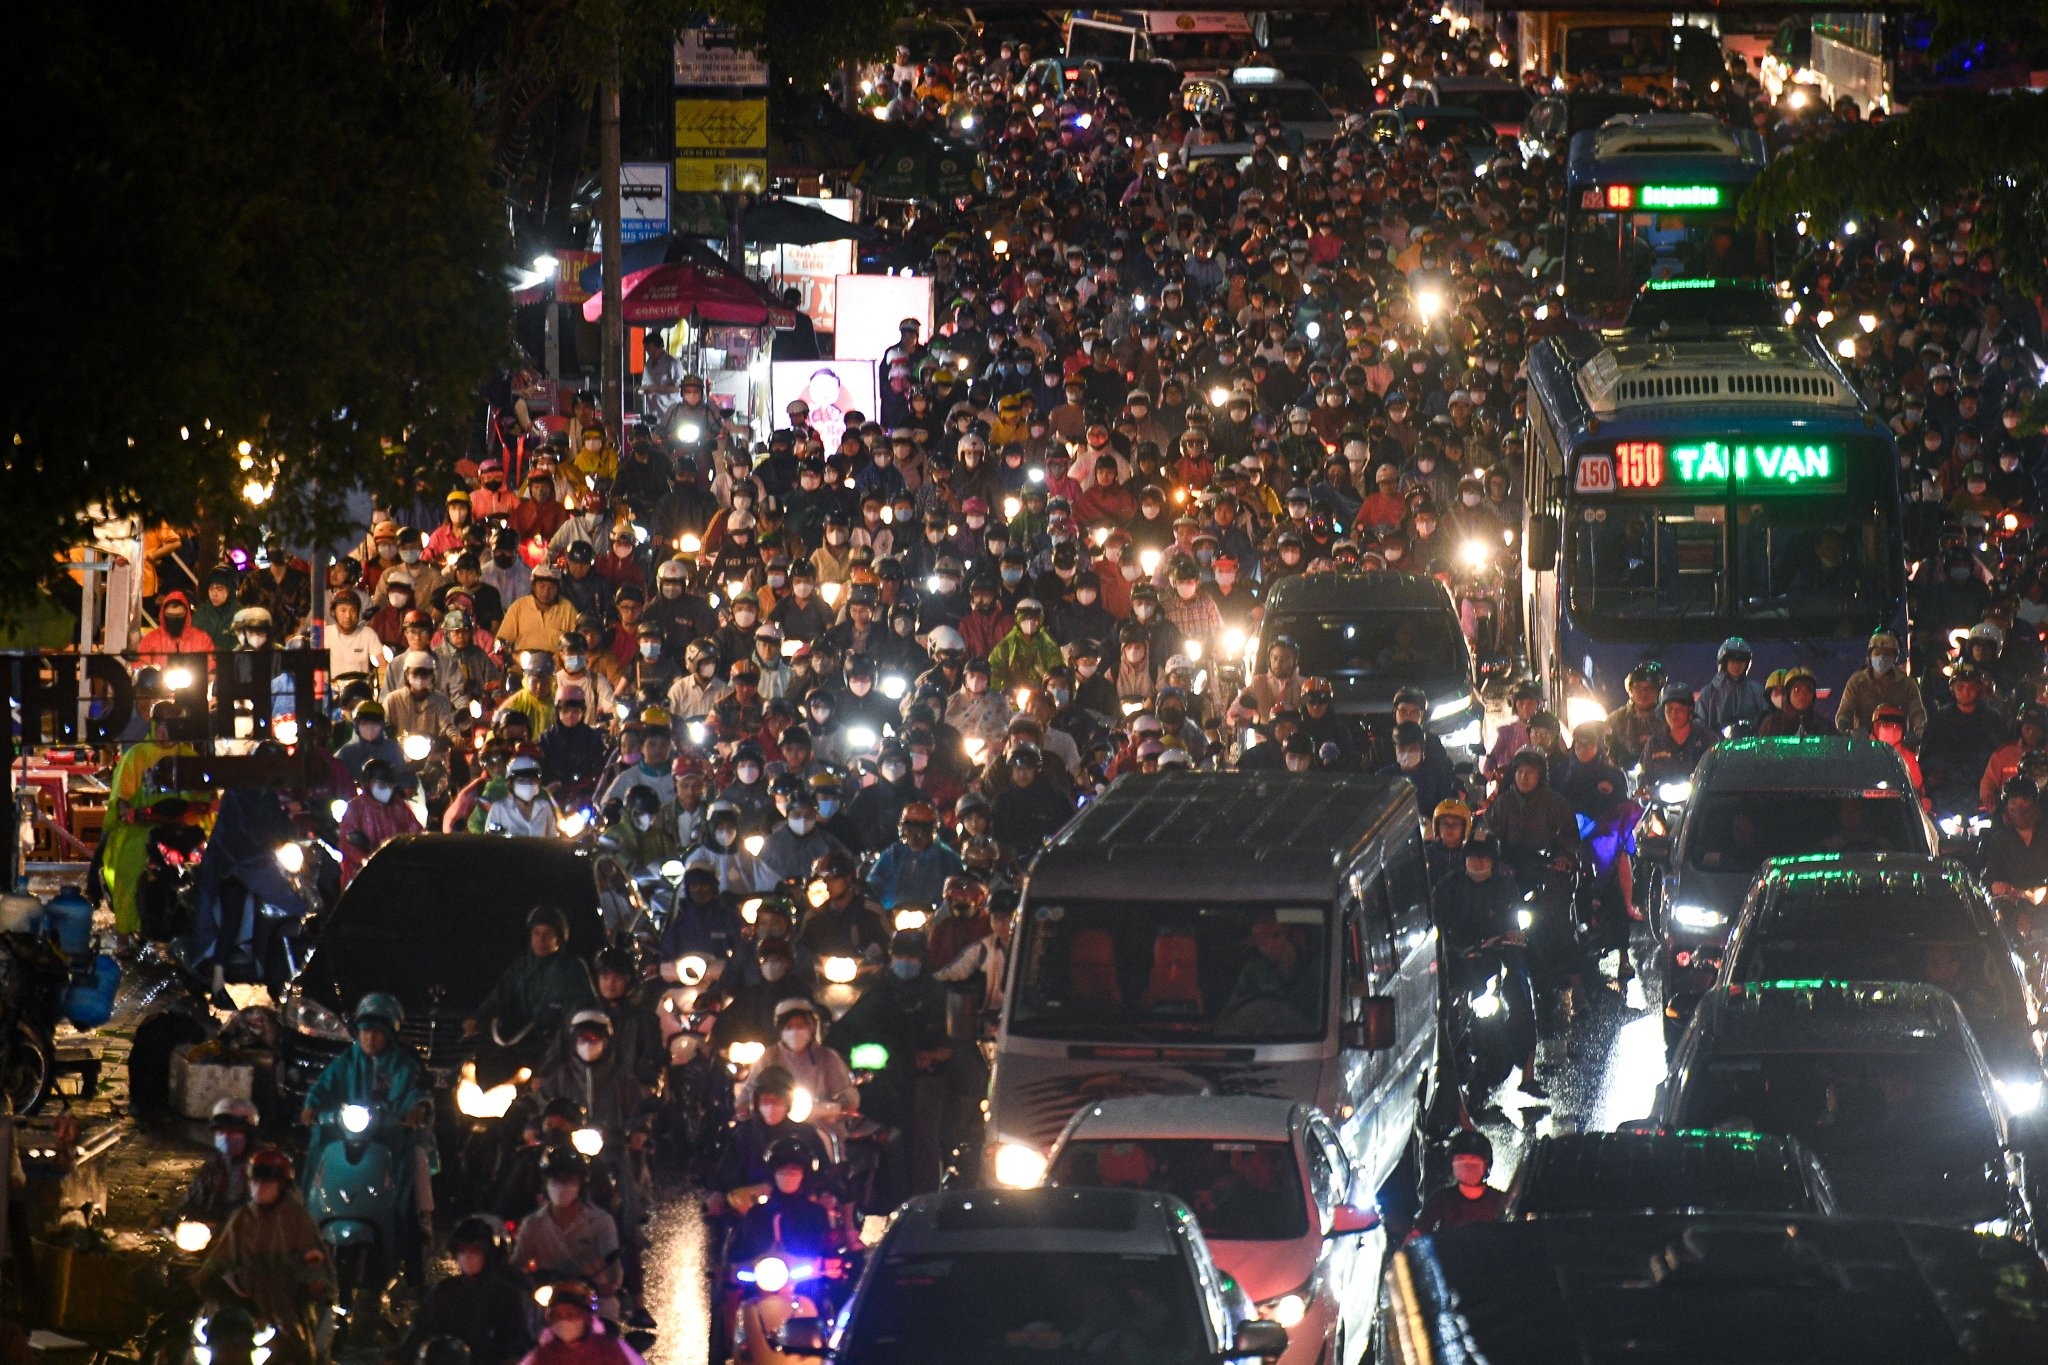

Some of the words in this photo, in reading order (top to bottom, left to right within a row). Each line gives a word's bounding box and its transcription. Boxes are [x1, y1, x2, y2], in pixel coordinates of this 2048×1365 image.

[1608, 185, 1631, 208] 52
[1580, 461, 1610, 488] 150
[1615, 442, 1661, 488] 150
[1676, 441, 1748, 482] TÂN
[1755, 445, 1829, 483] VẠN
